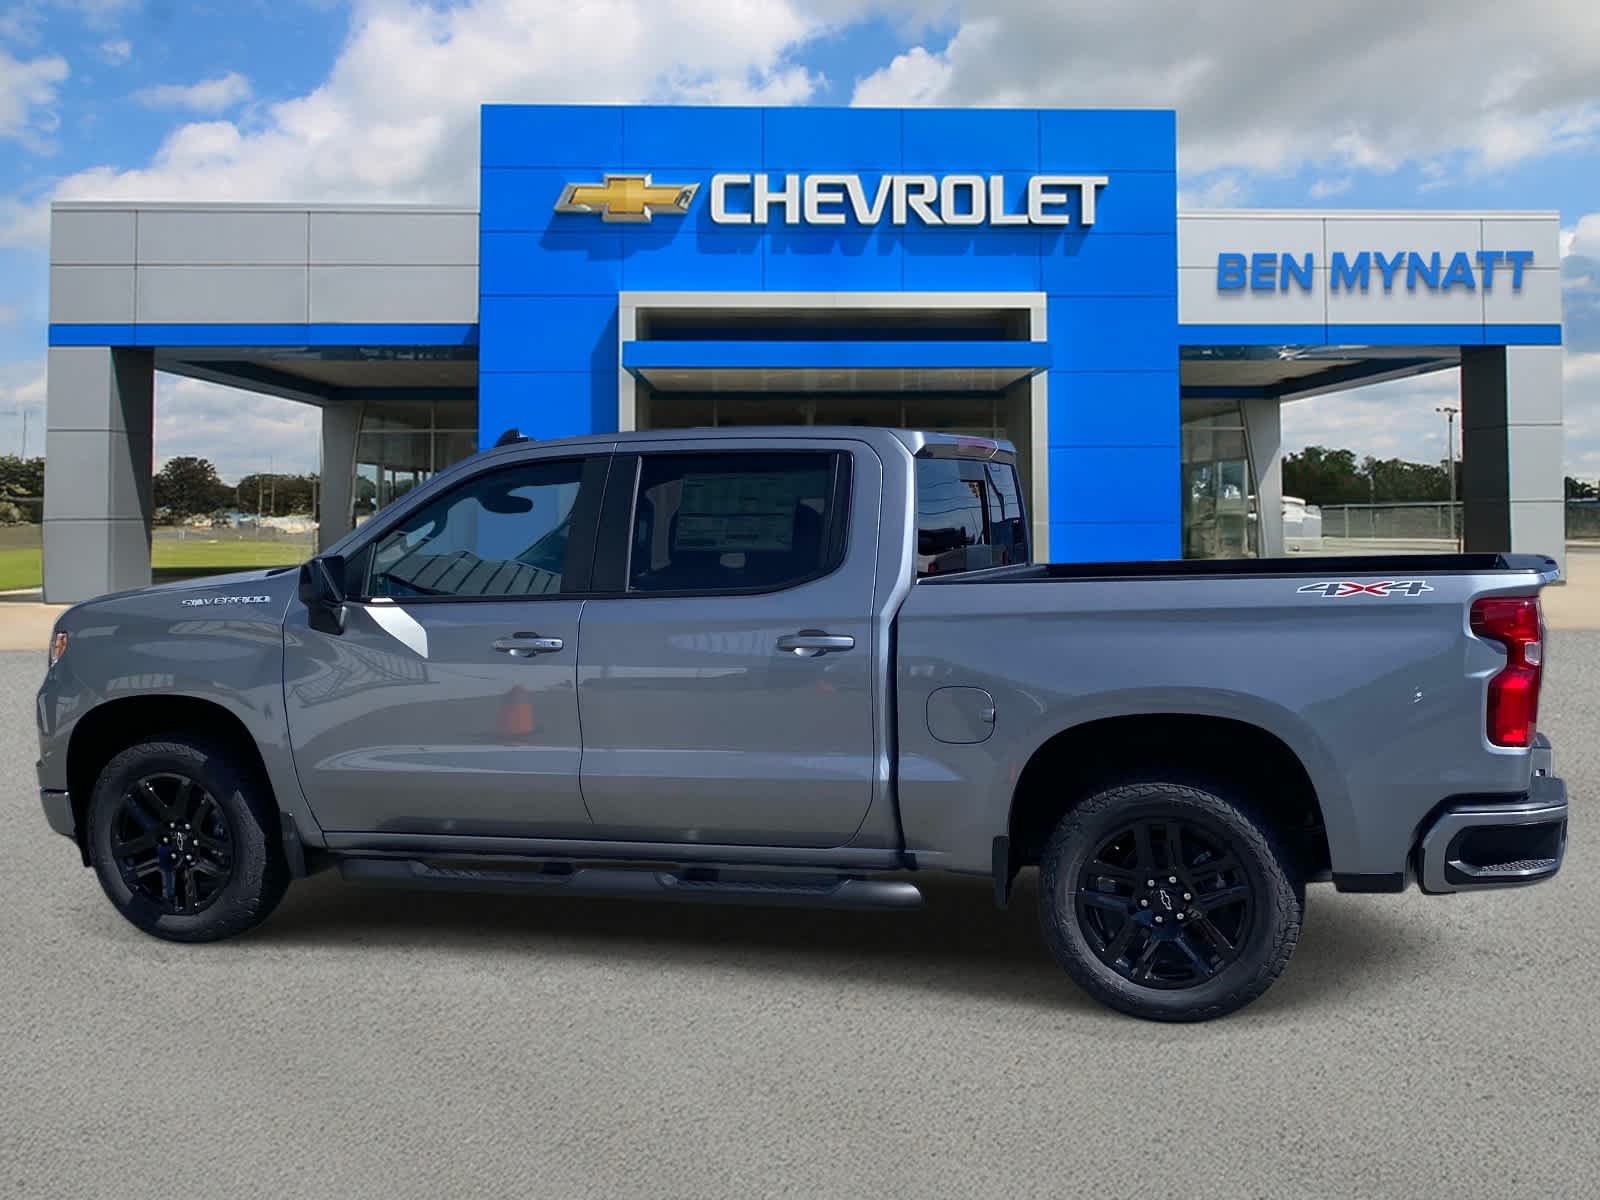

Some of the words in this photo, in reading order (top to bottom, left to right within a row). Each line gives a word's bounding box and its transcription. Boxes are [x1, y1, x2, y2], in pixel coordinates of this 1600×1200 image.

[710, 173, 1109, 225] CHEVROLET
[1217, 252, 1313, 290] BEN
[1330, 250, 1534, 290] MYNATT
[181, 595, 271, 608] SILVERADO
